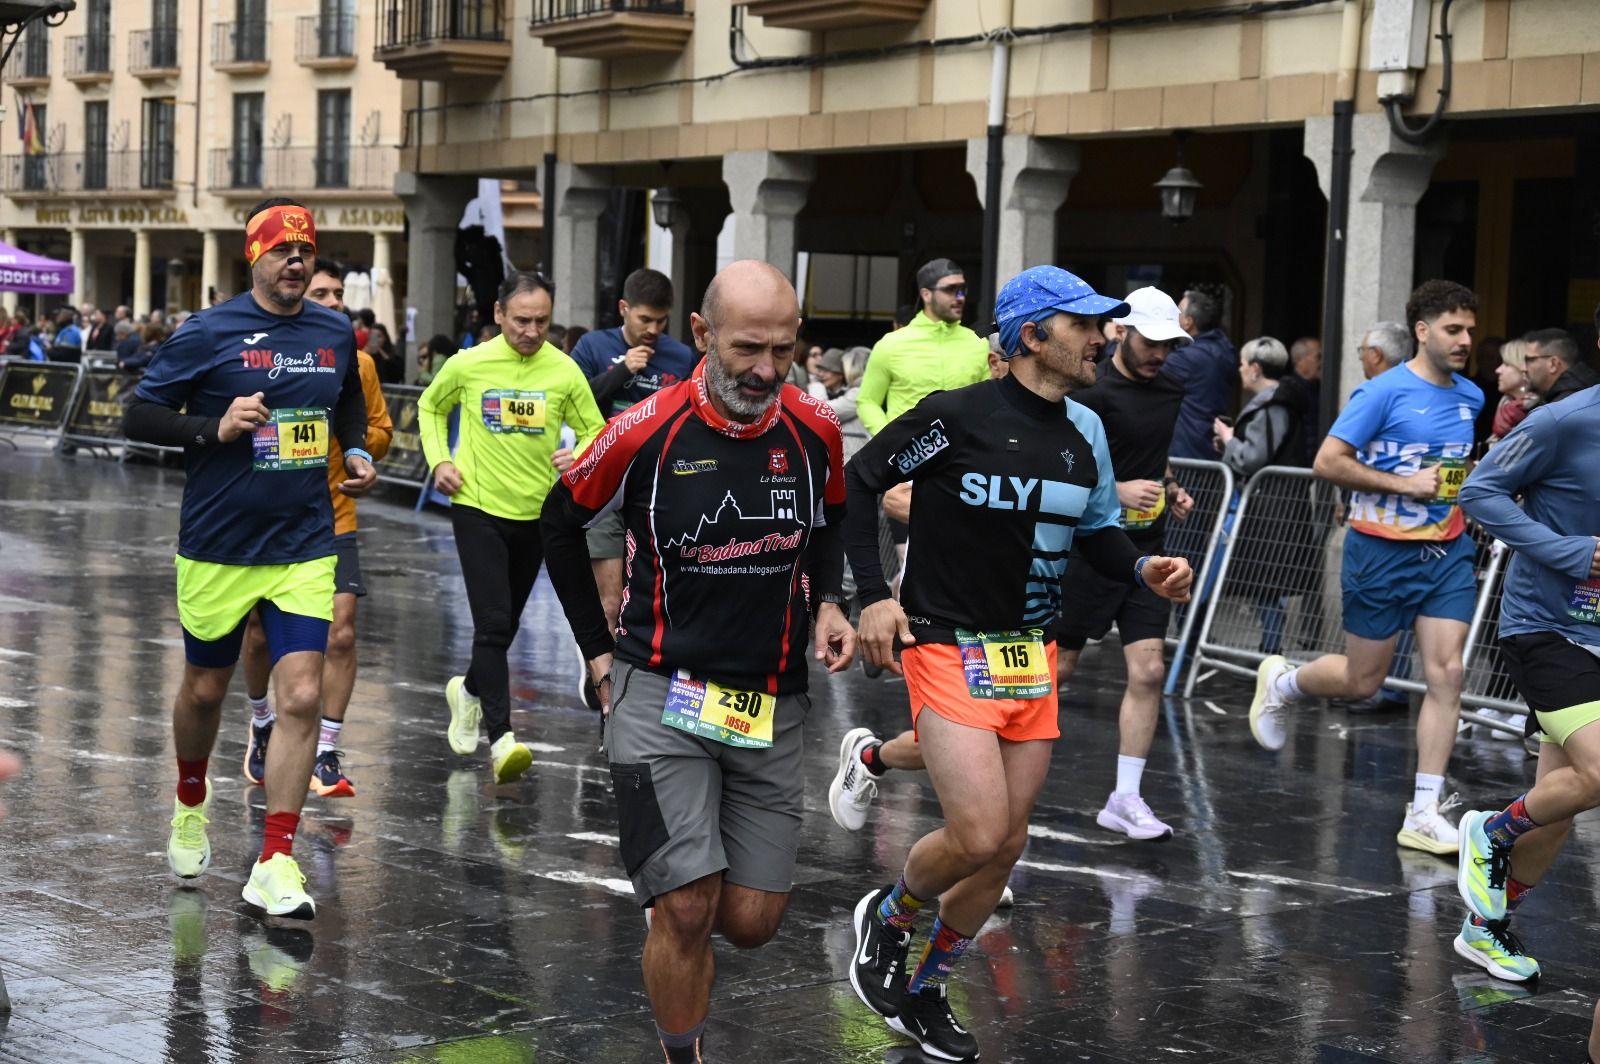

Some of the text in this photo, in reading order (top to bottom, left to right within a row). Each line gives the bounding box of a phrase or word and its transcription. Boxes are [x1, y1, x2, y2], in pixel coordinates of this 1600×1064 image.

[240, 349, 275, 368] 10K
[508, 400, 535, 416] 488
[615, 396, 657, 435] Trail
[292, 423, 316, 443] 141
[292, 447, 312, 457] Pedro
[959, 472, 1038, 511] SLY
[680, 529, 803, 563] La Badana Trail
[999, 644, 1029, 668] 115
[671, 687, 704, 702] ASTORGA
[673, 681, 696, 691] CIUDAD
[690, 699, 700, 709] 26
[718, 691, 763, 719] 290
